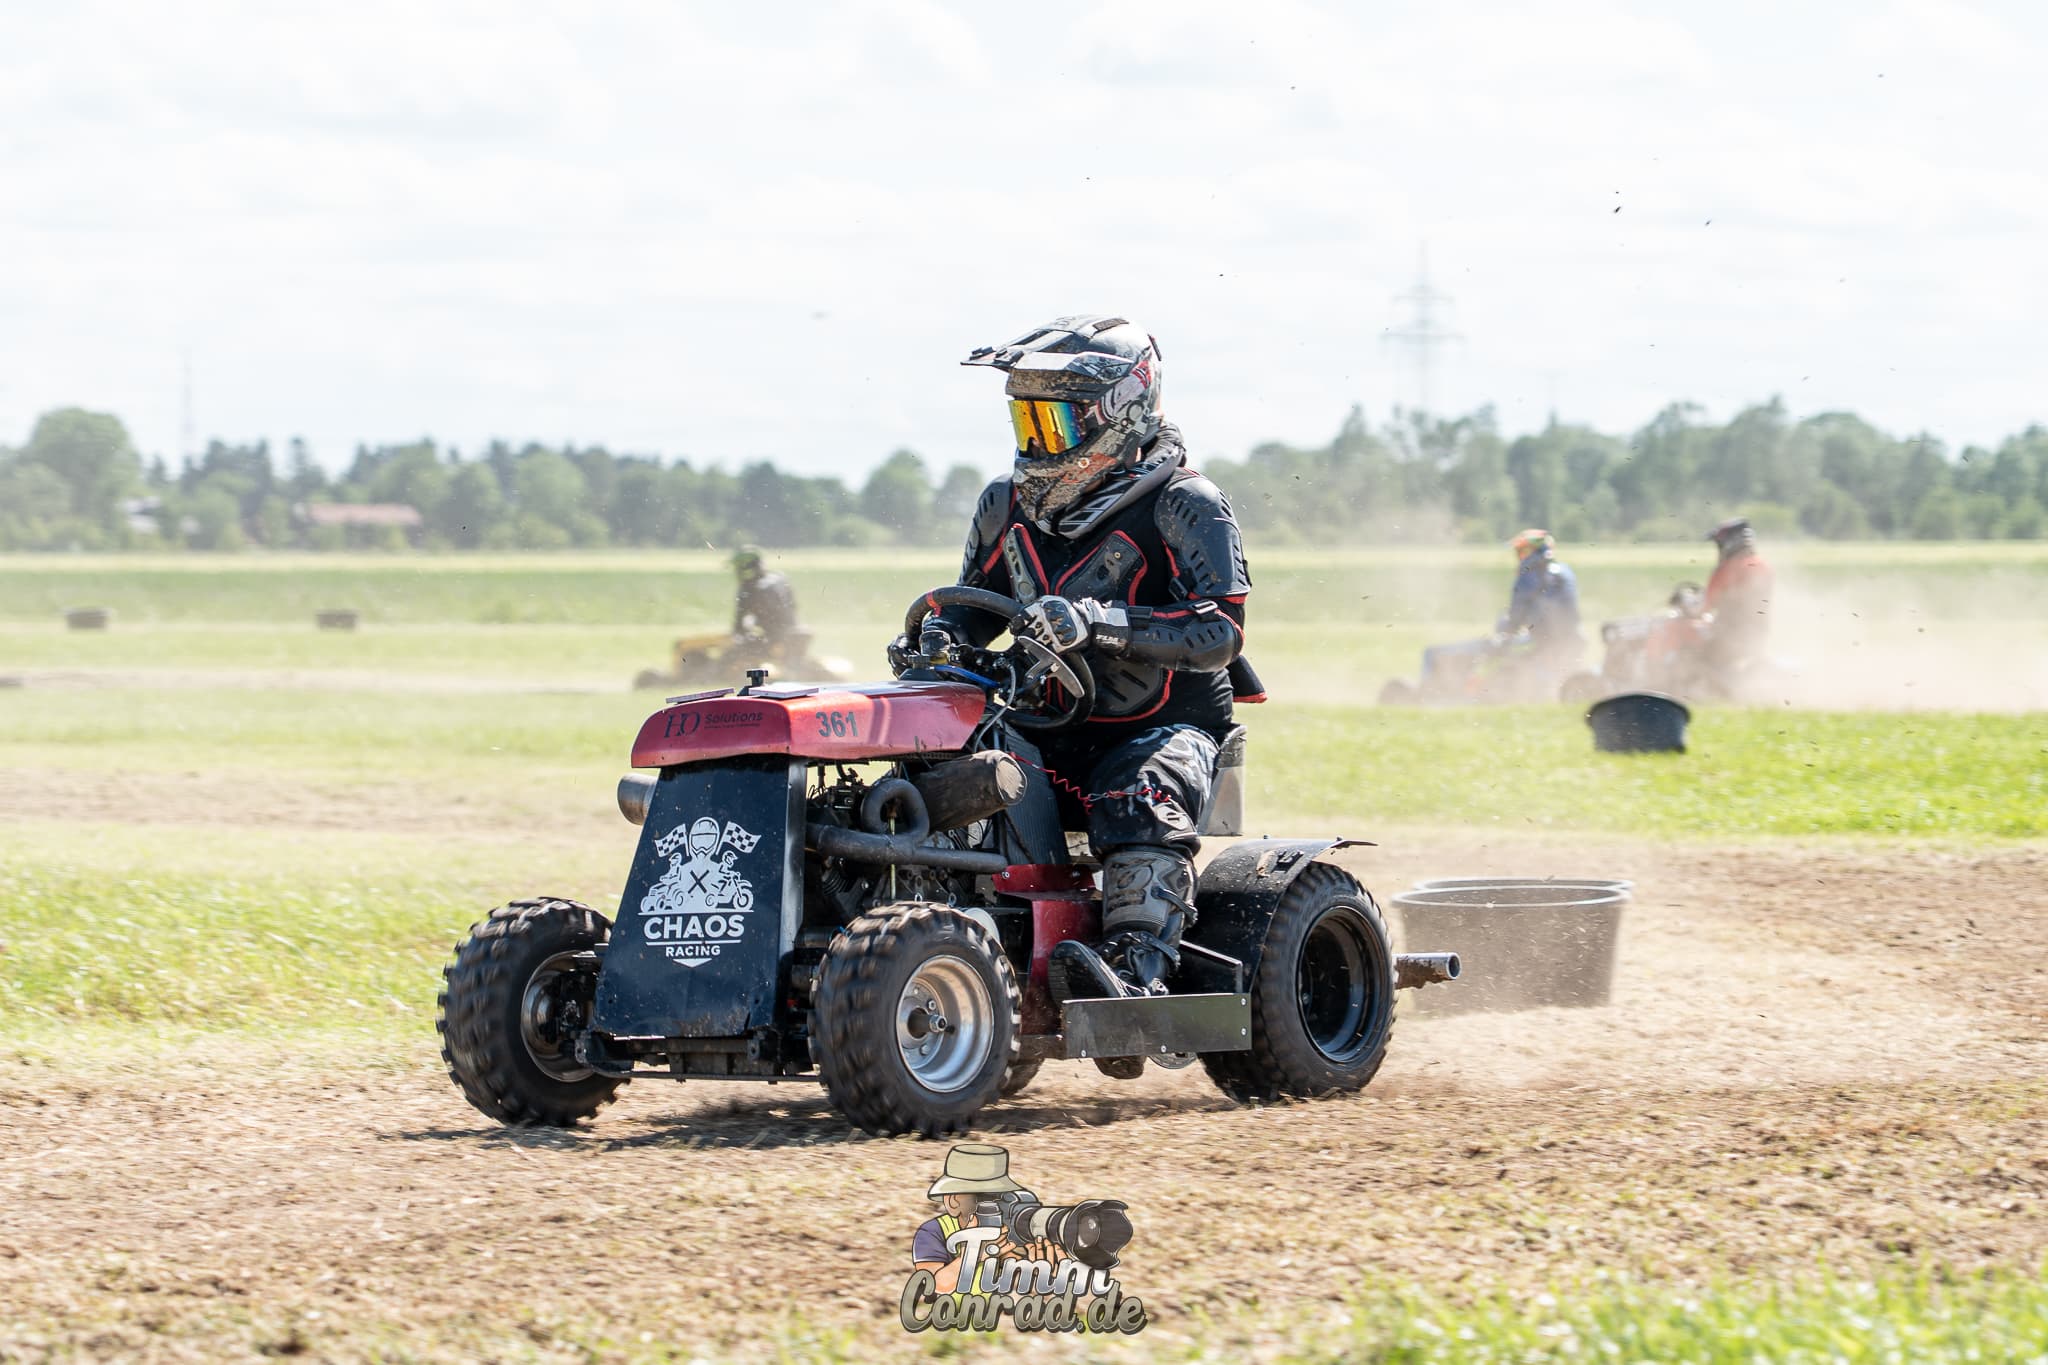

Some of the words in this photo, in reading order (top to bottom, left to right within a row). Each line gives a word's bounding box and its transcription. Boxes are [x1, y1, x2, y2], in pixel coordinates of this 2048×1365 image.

[704, 711, 763, 725] Solutions
[816, 711, 858, 737] 361
[643, 914, 745, 939] CHAOS
[665, 945, 721, 957] RACING
